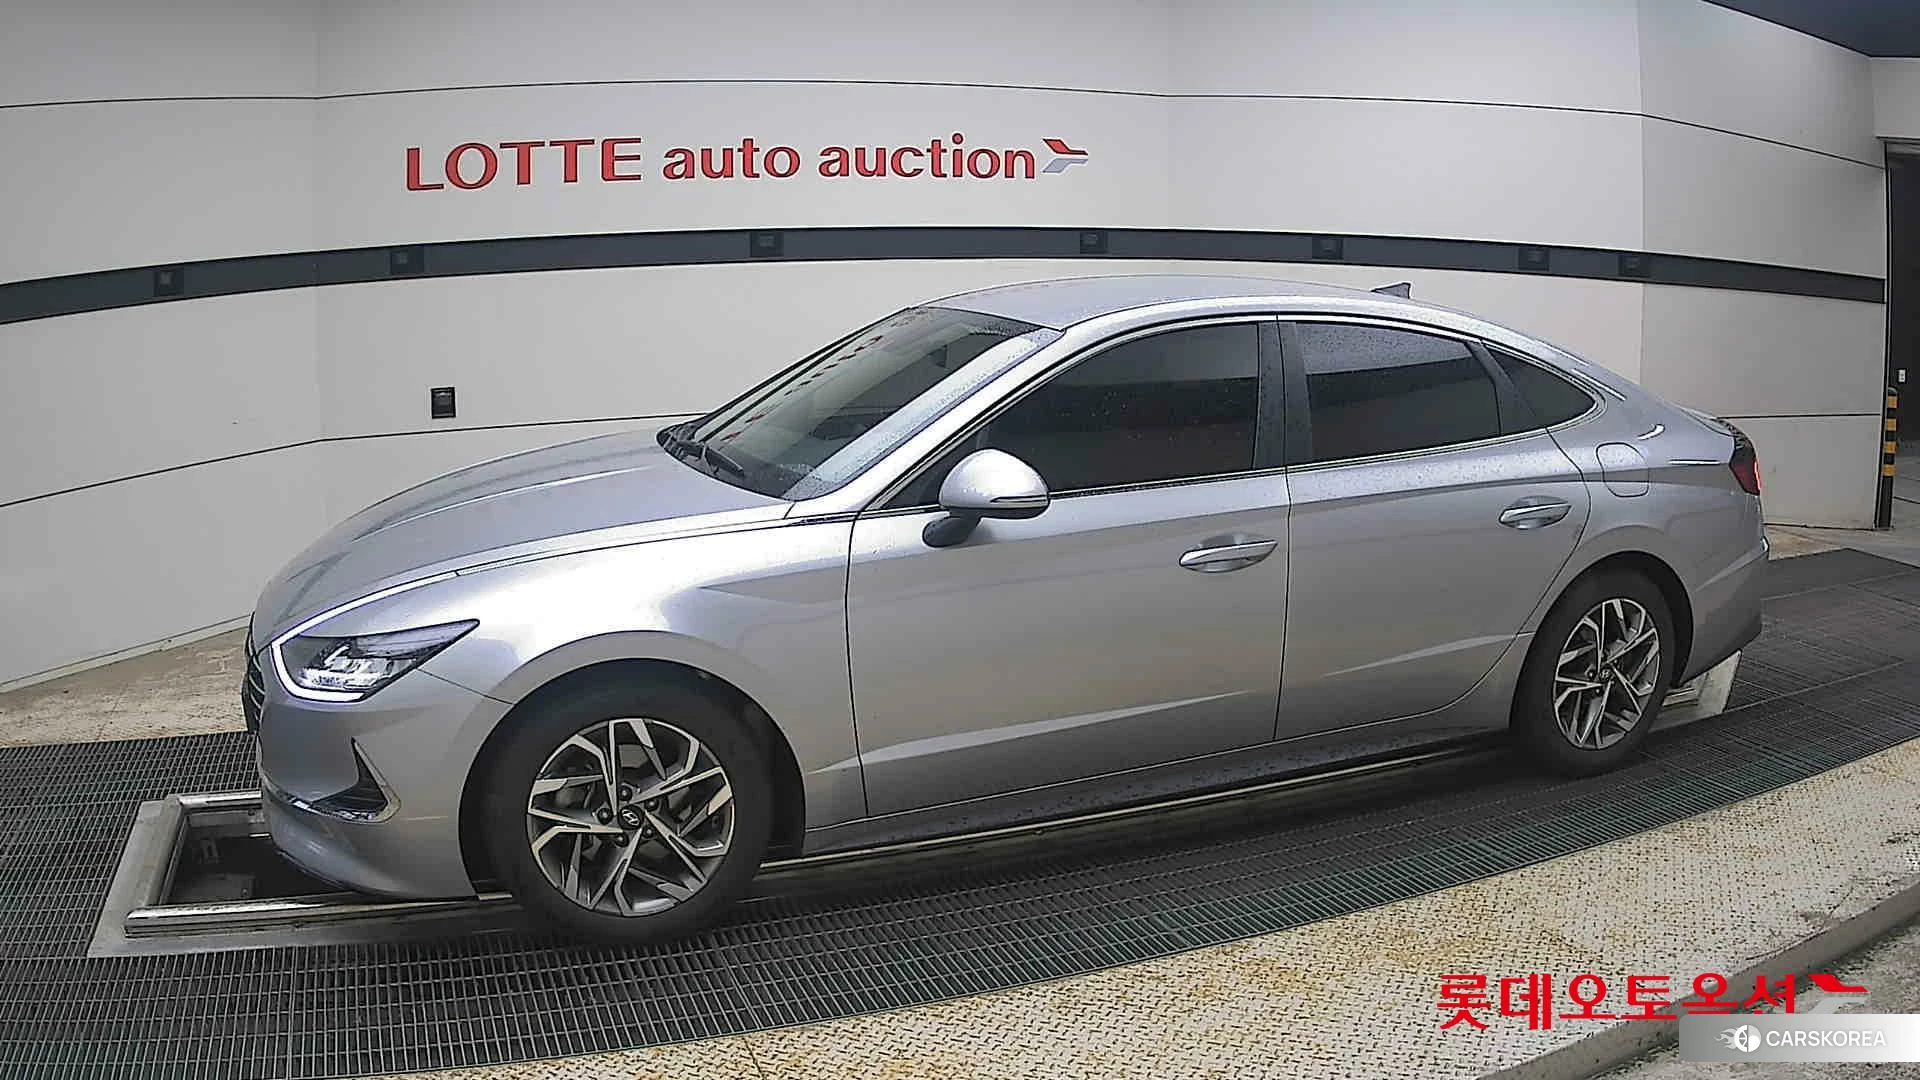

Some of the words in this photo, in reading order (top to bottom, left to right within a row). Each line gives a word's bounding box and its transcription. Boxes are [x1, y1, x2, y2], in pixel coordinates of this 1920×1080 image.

[406, 138, 641, 191] LOTTE
[663, 138, 801, 180] auto
[818, 133, 1036, 179] auction
